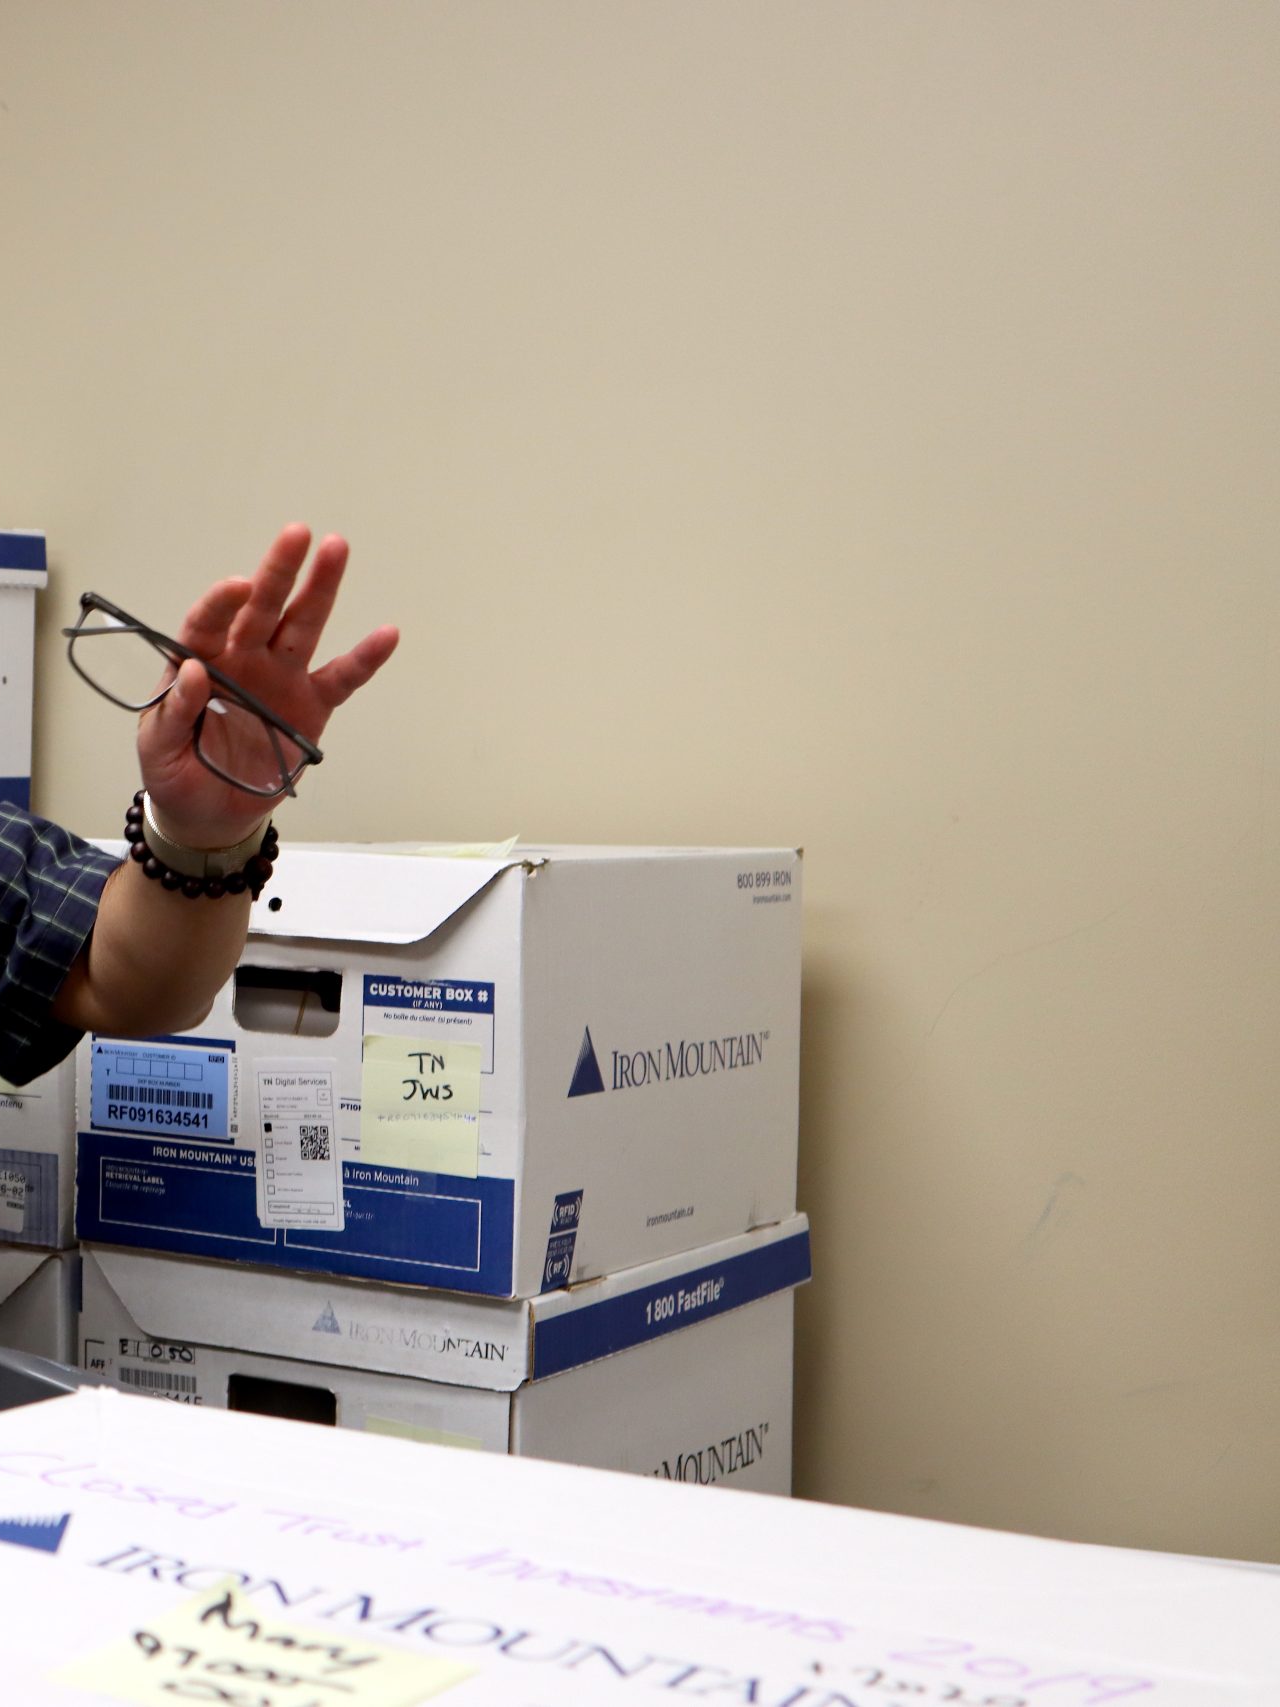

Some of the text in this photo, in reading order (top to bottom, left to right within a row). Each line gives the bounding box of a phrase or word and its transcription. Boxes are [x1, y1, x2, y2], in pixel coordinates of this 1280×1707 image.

[737, 870, 792, 889] 800 899 IRON
[369, 983, 488, 1002] CUSTOMER BOX #
[424, 1001, 443, 1010] ANY)
[419, 1015, 436, 1023] client
[408, 1052, 444, 1074] TN
[612, 1031, 764, 1090] IRON MOUNTAIN
[275, 1078, 296, 1087] Digital
[298, 1078, 328, 1086] Services
[108, 1104, 209, 1129] RF091634541
[153, 1146, 177, 1158] IRON
[143, 1176, 164, 1185] LABEL
[344, 1167, 419, 1186] à Iron Mountain
[559, 1204, 575, 1217] RFID
[646, 1302, 652, 1325] 1
[654, 1294, 674, 1322] 800
[90, 1544, 326, 1608] IRON
